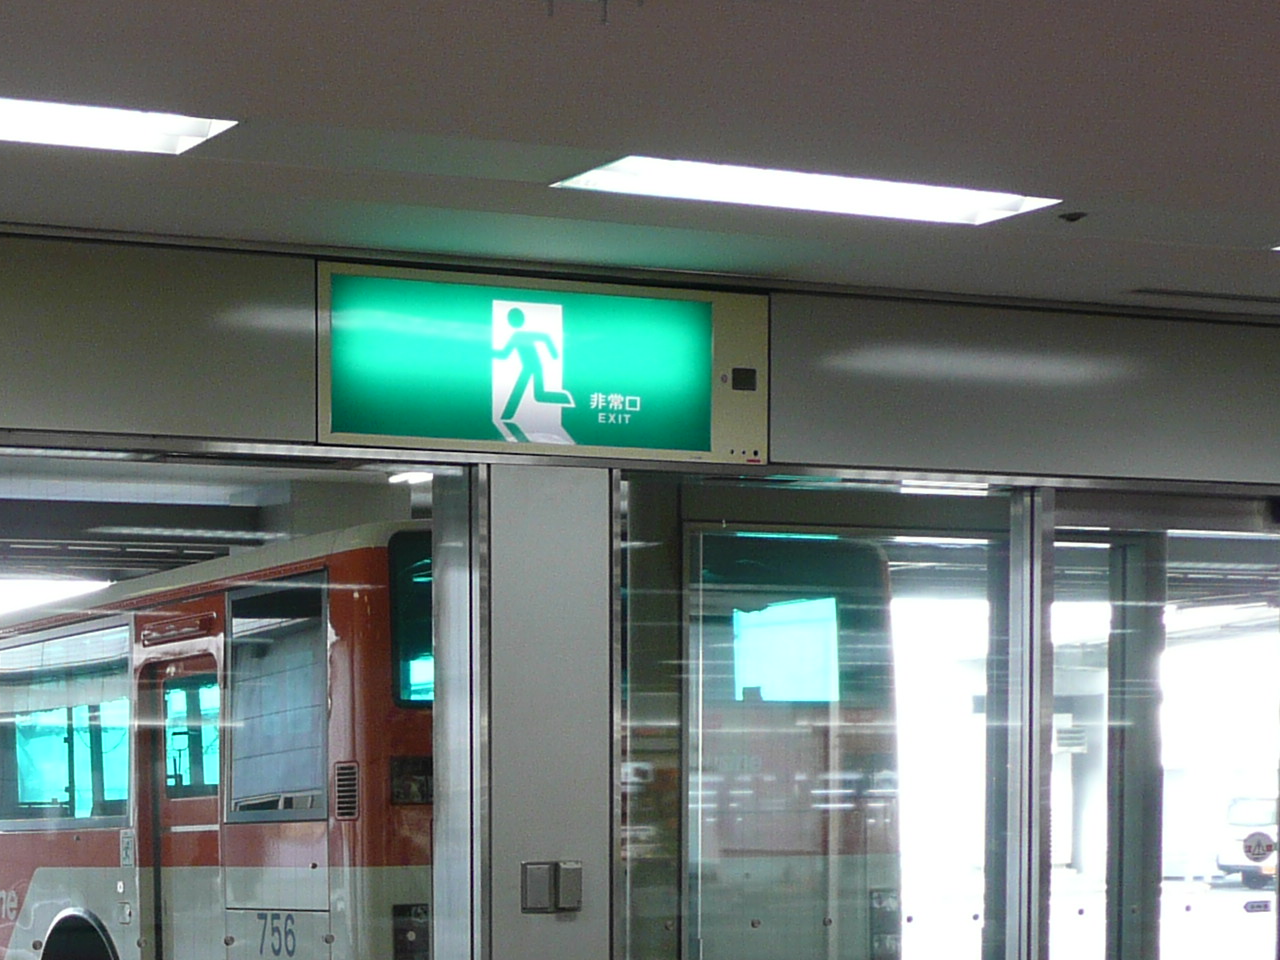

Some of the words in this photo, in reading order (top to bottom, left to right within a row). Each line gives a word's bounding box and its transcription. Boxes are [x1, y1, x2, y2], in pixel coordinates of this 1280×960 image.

[589, 392, 641, 411] 非常口
[598, 413, 631, 424] EXIT
[257, 912, 296, 958] 756
